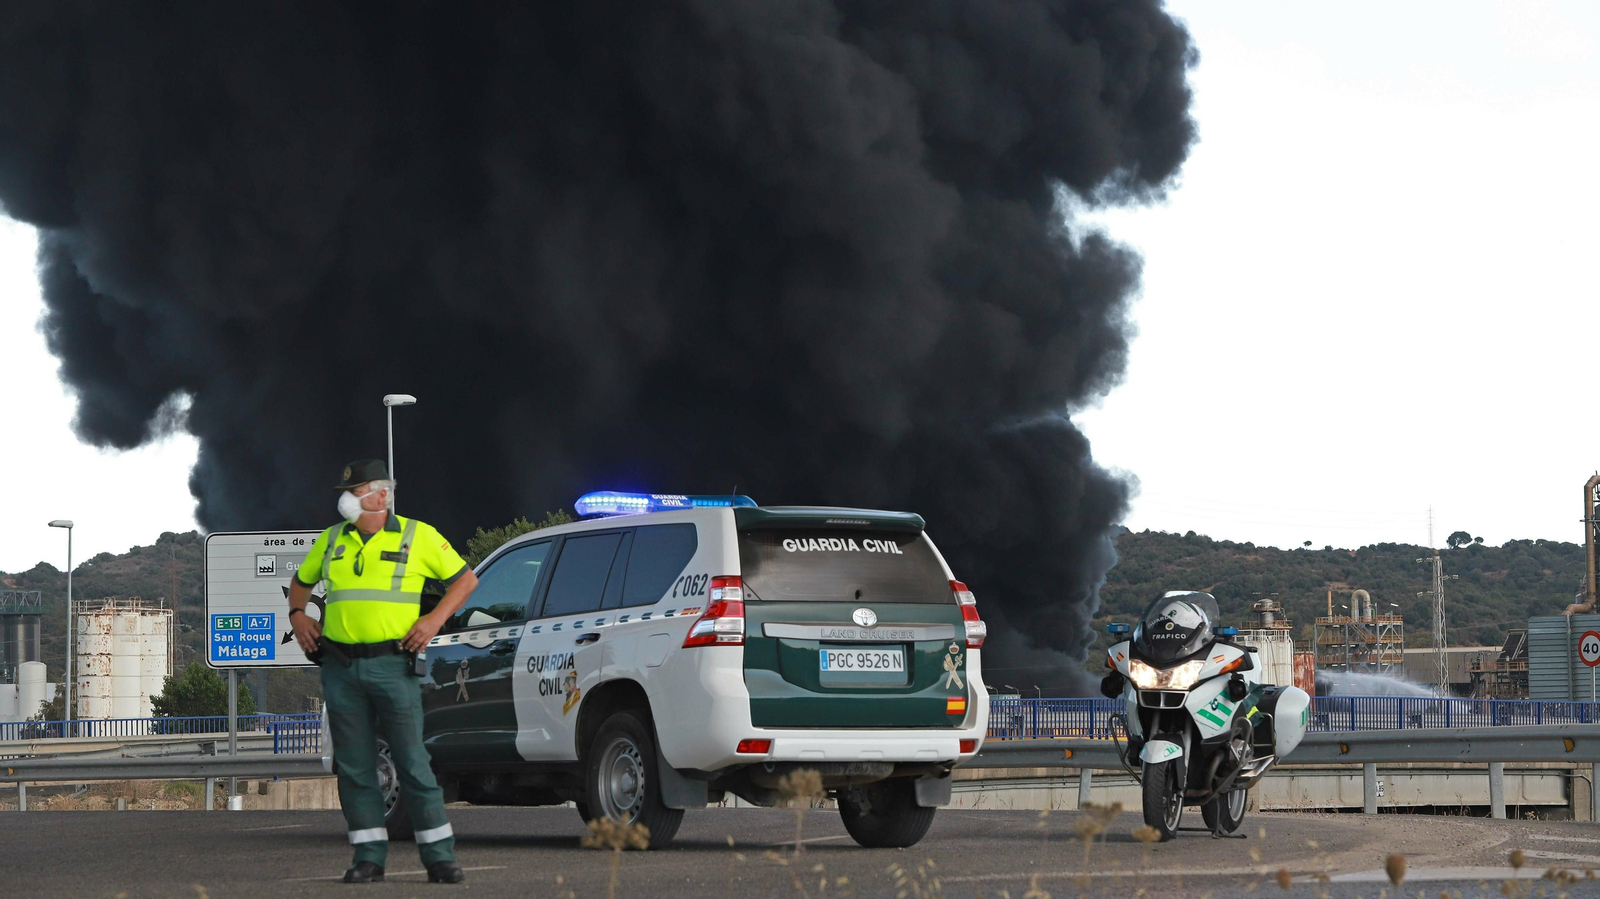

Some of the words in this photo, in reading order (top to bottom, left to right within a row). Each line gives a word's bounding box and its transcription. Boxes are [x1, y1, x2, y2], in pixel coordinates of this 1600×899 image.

[263, 537, 286, 546] área
[292, 537, 305, 546] de
[782, 538, 860, 552] GUARDIA
[862, 538, 903, 554] CIVIL
[682, 573, 708, 597] 062
[217, 618, 241, 628] E-15
[250, 617, 269, 628] A-7
[214, 633, 234, 642] San
[239, 632, 272, 643] Roque
[820, 628, 857, 639] LAND
[859, 629, 915, 639] CRUISER
[218, 645, 268, 659] Málaga
[1583, 643, 1599, 654] 40
[526, 652, 575, 674] GUARDIA
[828, 653, 854, 668] PGC
[856, 653, 890, 668] 9526
[892, 653, 902, 669] N
[538, 678, 563, 697] CIVIL
